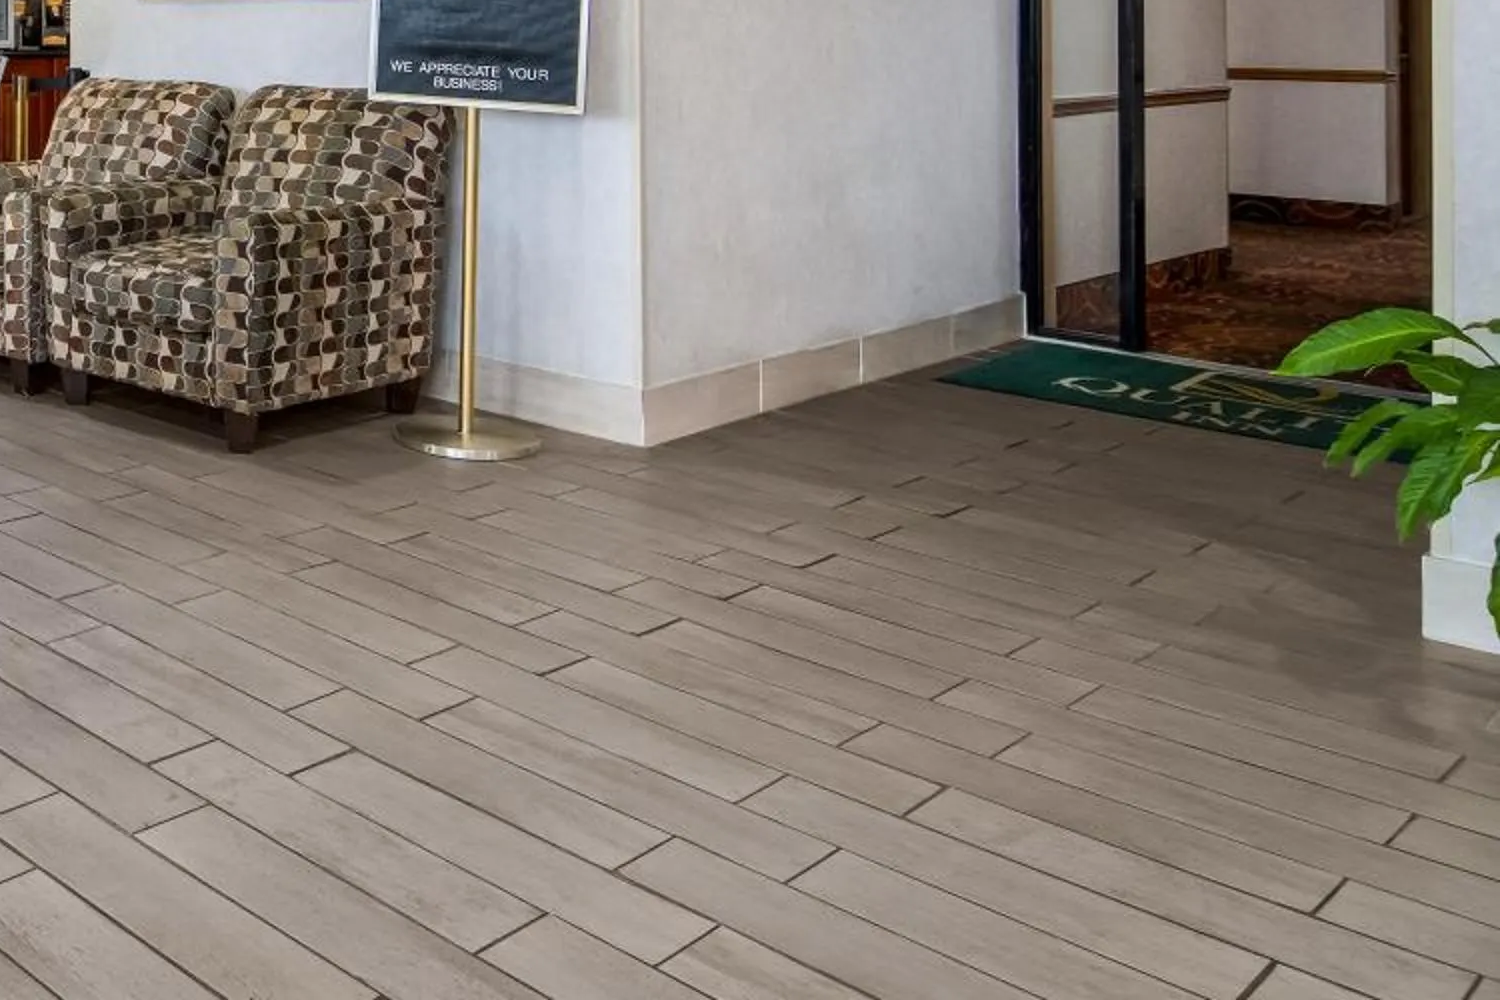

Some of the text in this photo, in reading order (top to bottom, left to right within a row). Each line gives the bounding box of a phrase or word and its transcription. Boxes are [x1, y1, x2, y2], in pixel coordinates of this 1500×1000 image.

[390, 60, 549, 81] WE APPRECIATE YOUR
[1051, 376, 1350, 431] QUALI
